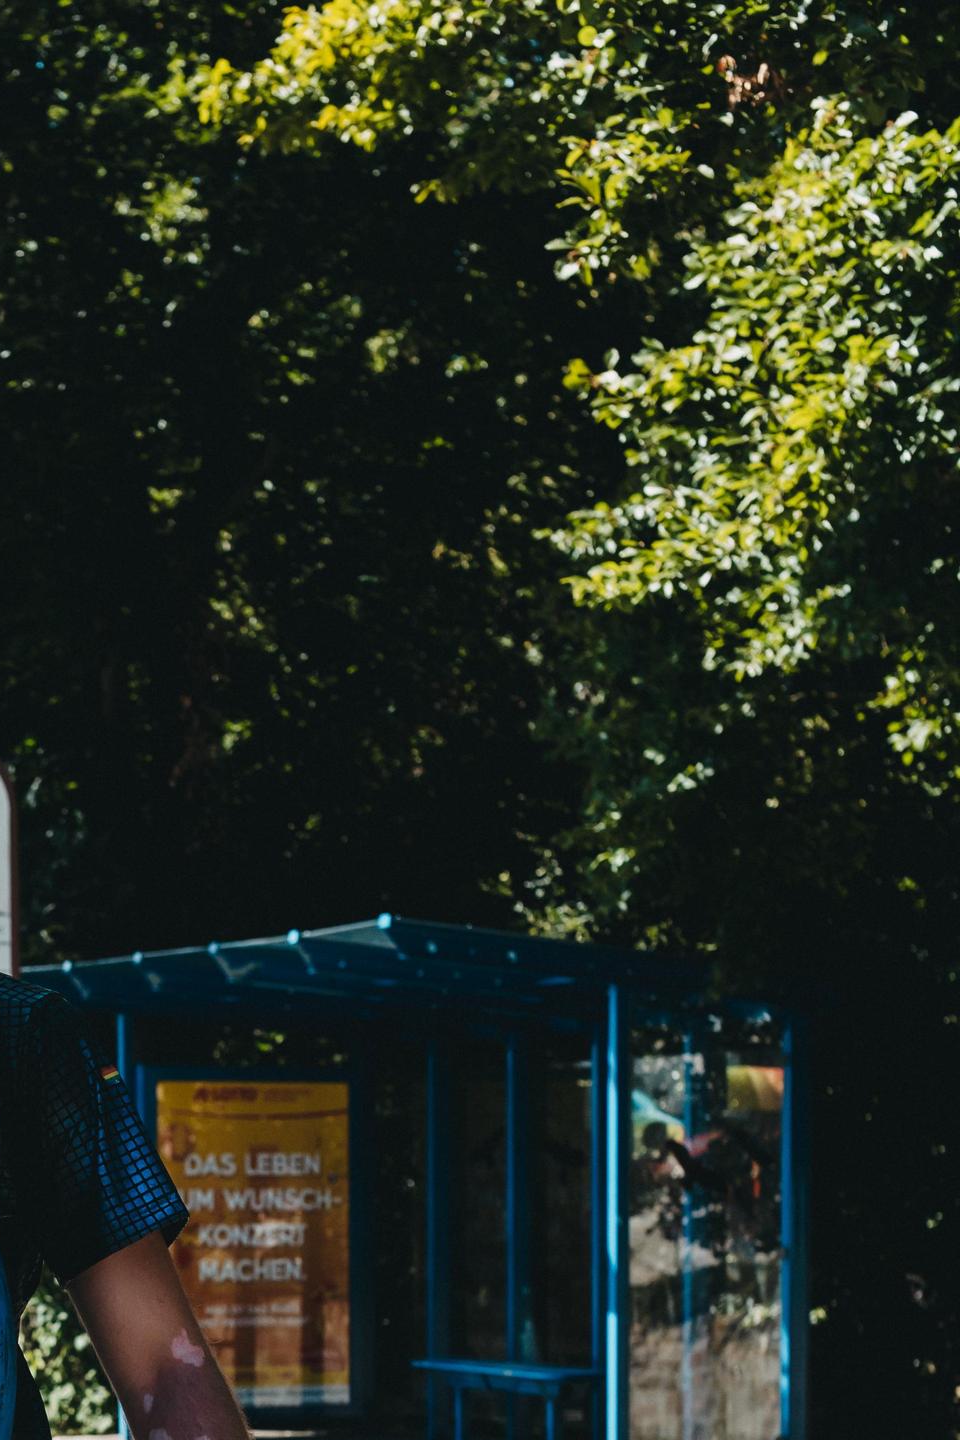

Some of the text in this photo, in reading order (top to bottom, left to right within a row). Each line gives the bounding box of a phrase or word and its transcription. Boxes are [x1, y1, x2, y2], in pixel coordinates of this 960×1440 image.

[184, 1152, 320, 1177] DAS LEBEN
[181, 1187, 343, 1213] UM WUNSCH-
[198, 1223, 306, 1248] KONZERT
